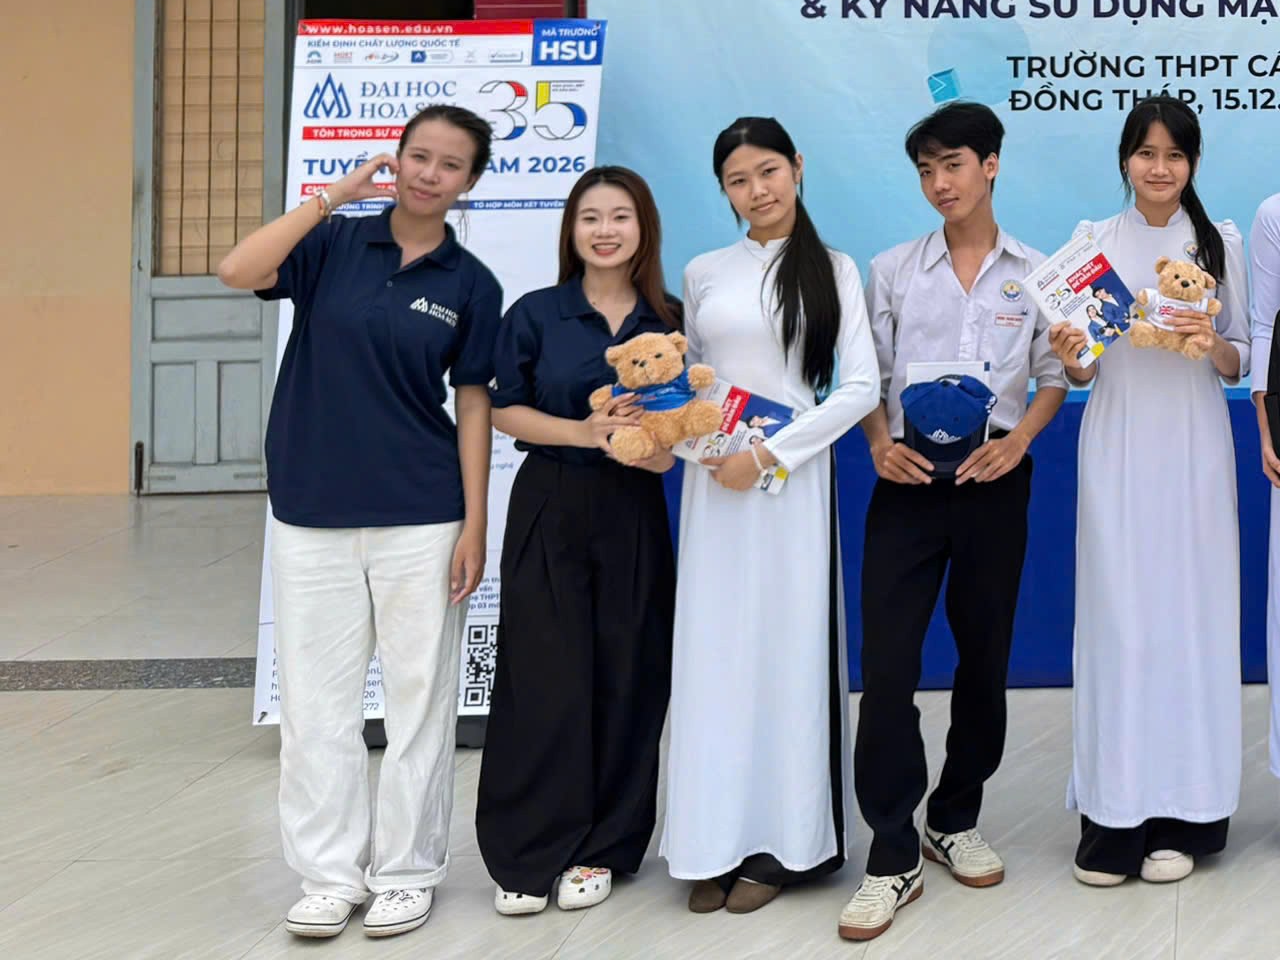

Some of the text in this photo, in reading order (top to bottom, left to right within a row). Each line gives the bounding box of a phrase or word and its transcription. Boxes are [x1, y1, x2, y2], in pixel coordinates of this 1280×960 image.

[307, 23, 453, 34] www.hoasen.edu.vn
[541, 27, 557, 37] MÃ
[332, 40, 356, 49] ĐỊNH
[539, 40, 598, 61] HSU
[1006, 49, 1145, 79] TRƯỜNG
[1155, 55, 1239, 77] THPT
[361, 81, 457, 100] ĐẠI HỌC
[1008, 81, 1102, 111] ĐỒNG
[360, 102, 409, 119] HOA
[313, 127, 335, 138] TÔN
[336, 127, 373, 140] TRỌNG
[527, 156, 586, 173] 2026
